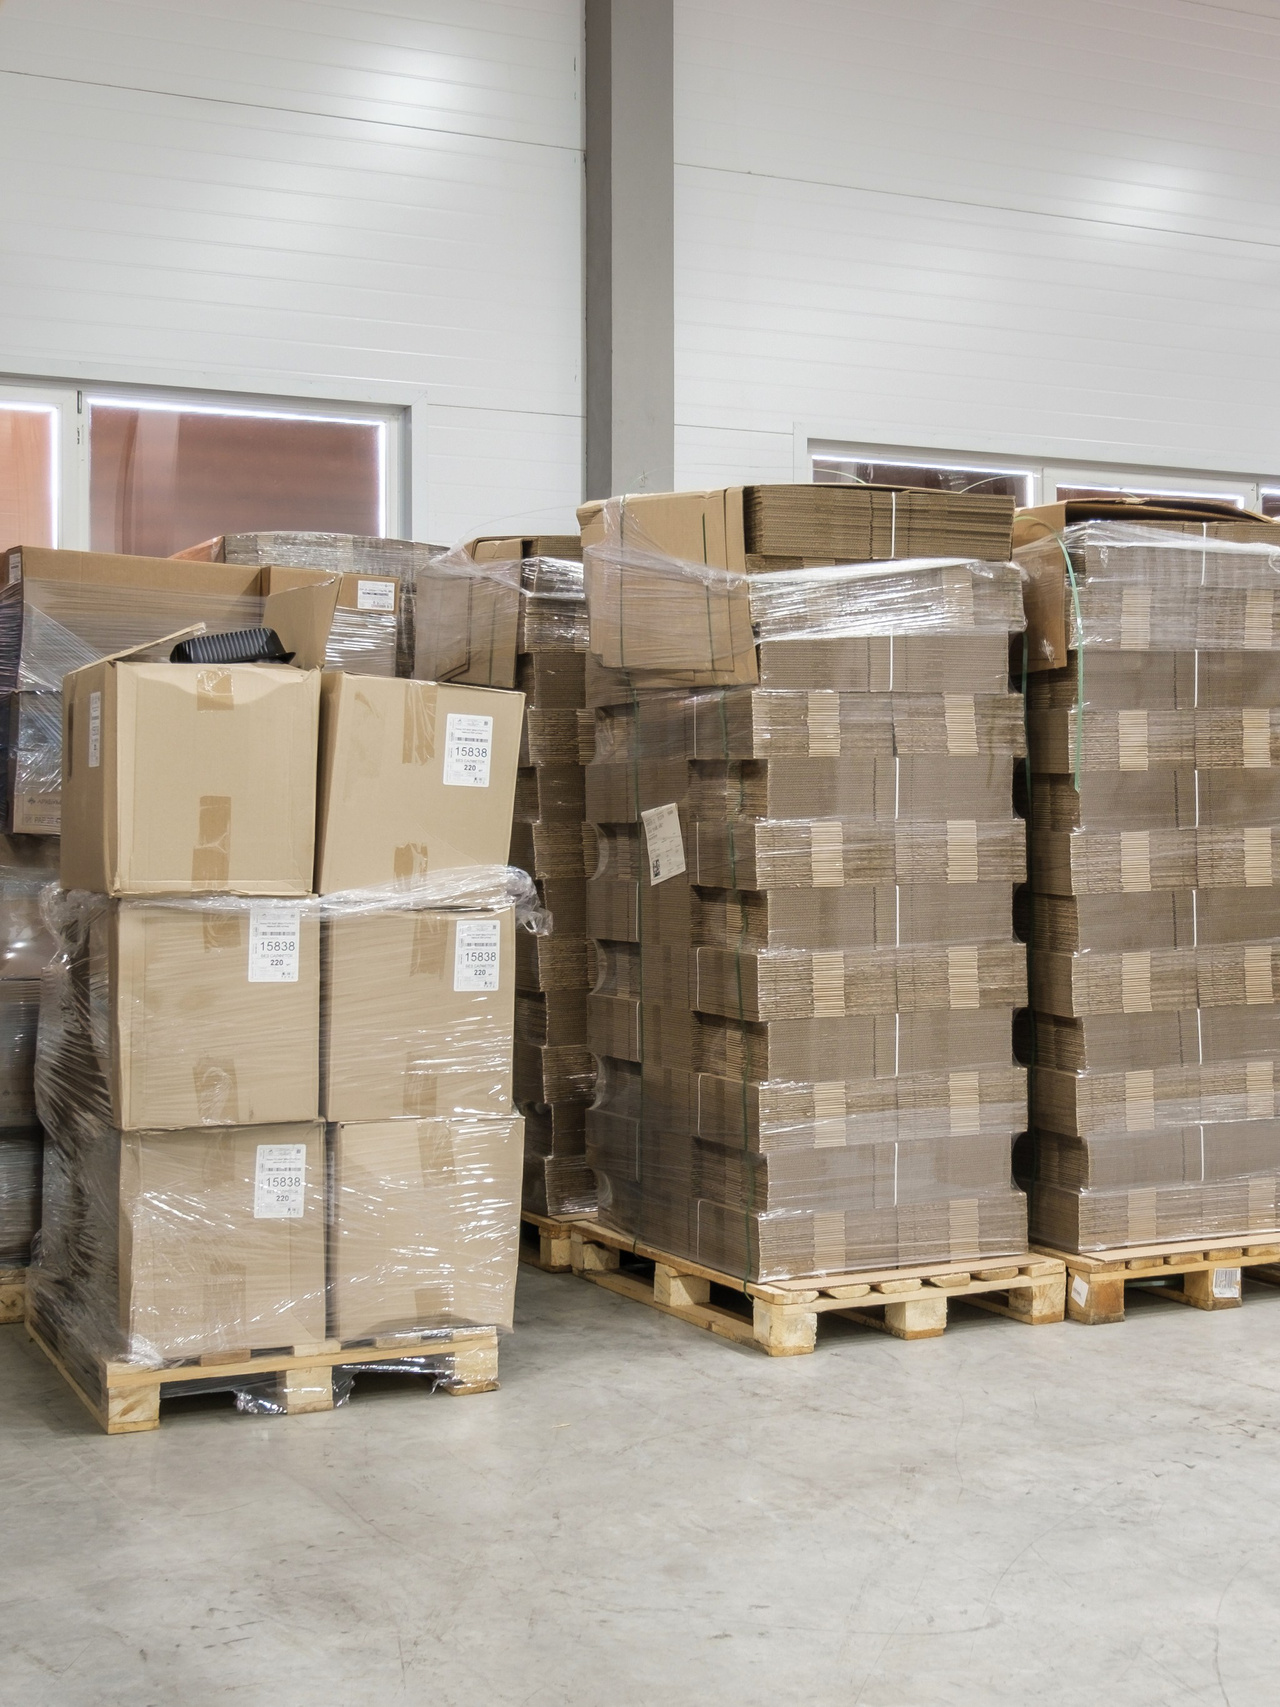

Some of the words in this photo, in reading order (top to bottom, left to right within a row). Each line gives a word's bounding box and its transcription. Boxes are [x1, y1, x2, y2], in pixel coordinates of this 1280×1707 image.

[455, 747, 487, 758] 15838
[260, 941, 295, 951] 15838
[465, 952, 497, 962] 15838
[266, 1176, 301, 1187] 15838
